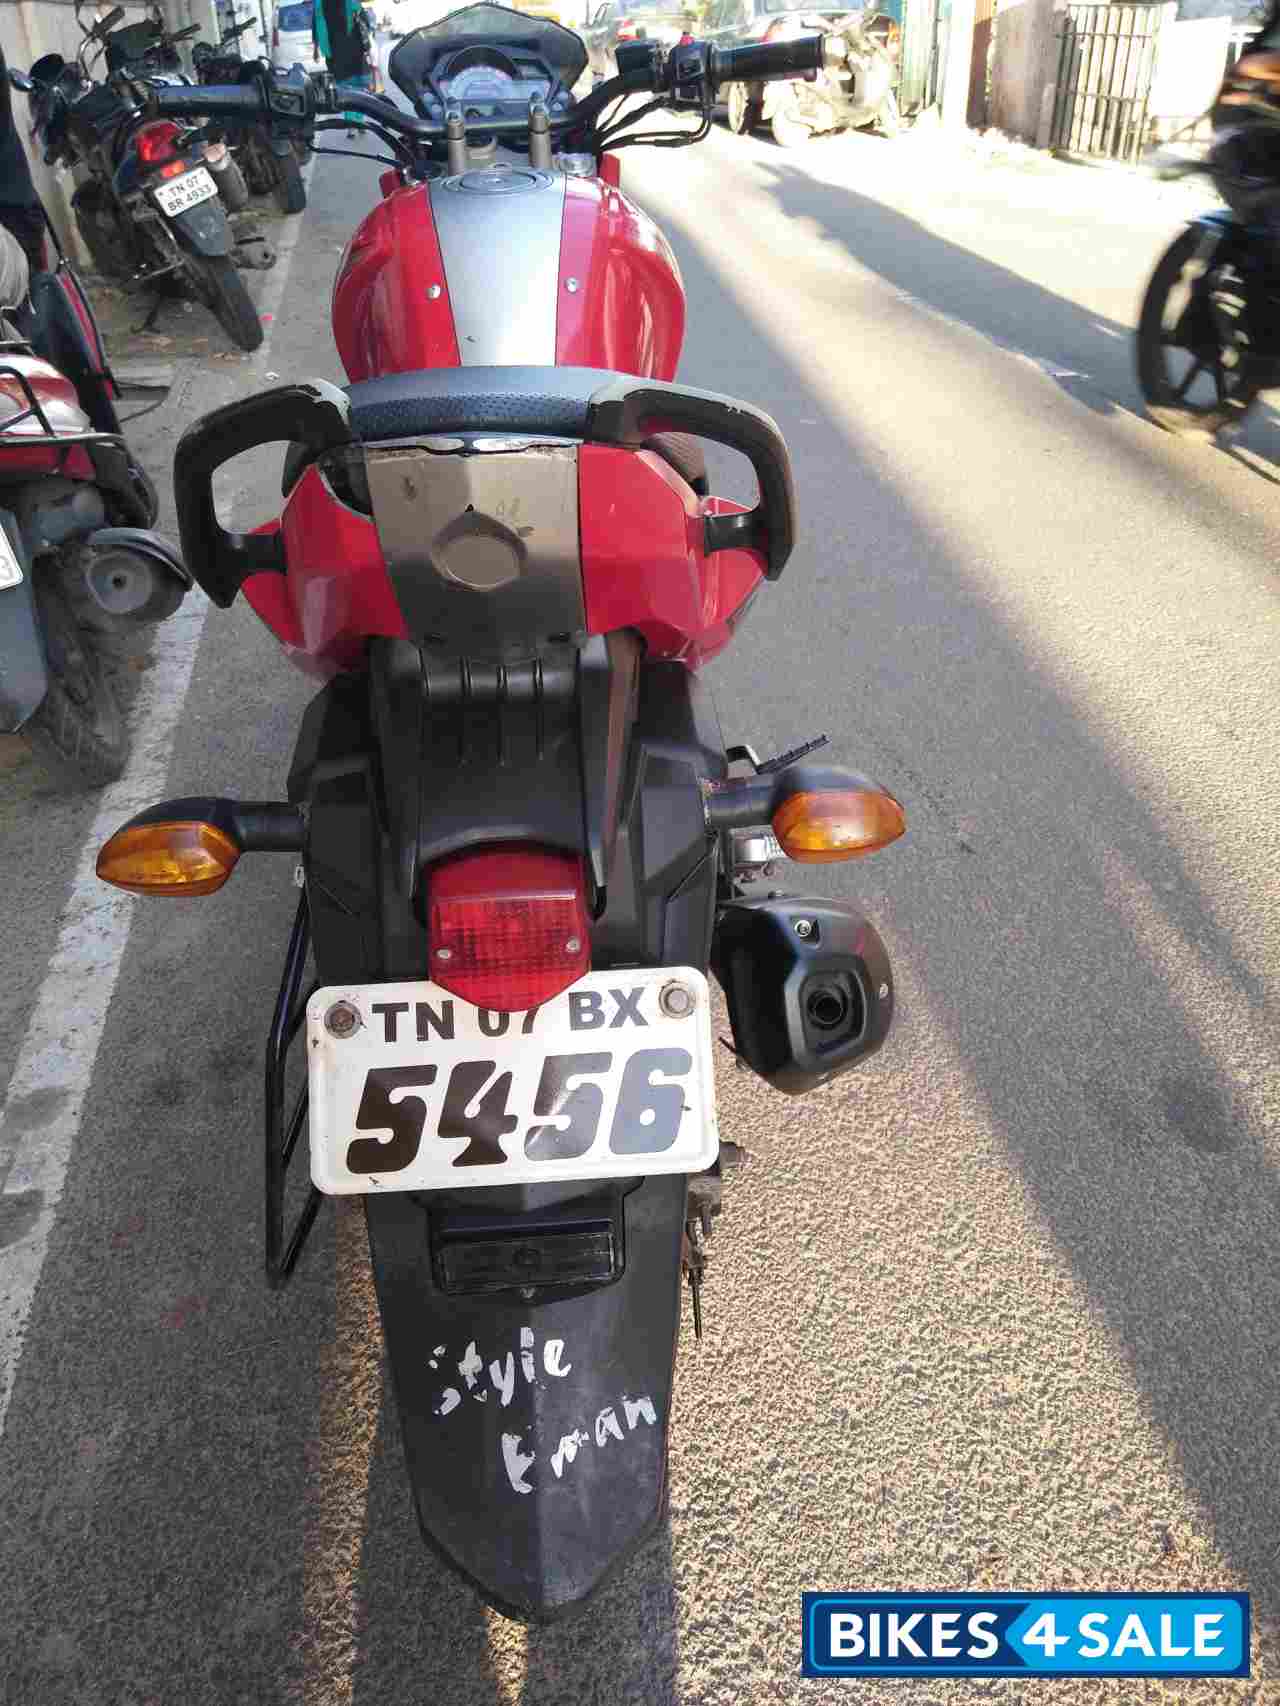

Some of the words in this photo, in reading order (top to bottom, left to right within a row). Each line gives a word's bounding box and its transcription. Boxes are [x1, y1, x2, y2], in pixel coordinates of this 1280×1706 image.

[372, 1000, 455, 1042] TN
[568, 986, 649, 1031] BX
[346, 1047, 693, 1174] 5456
